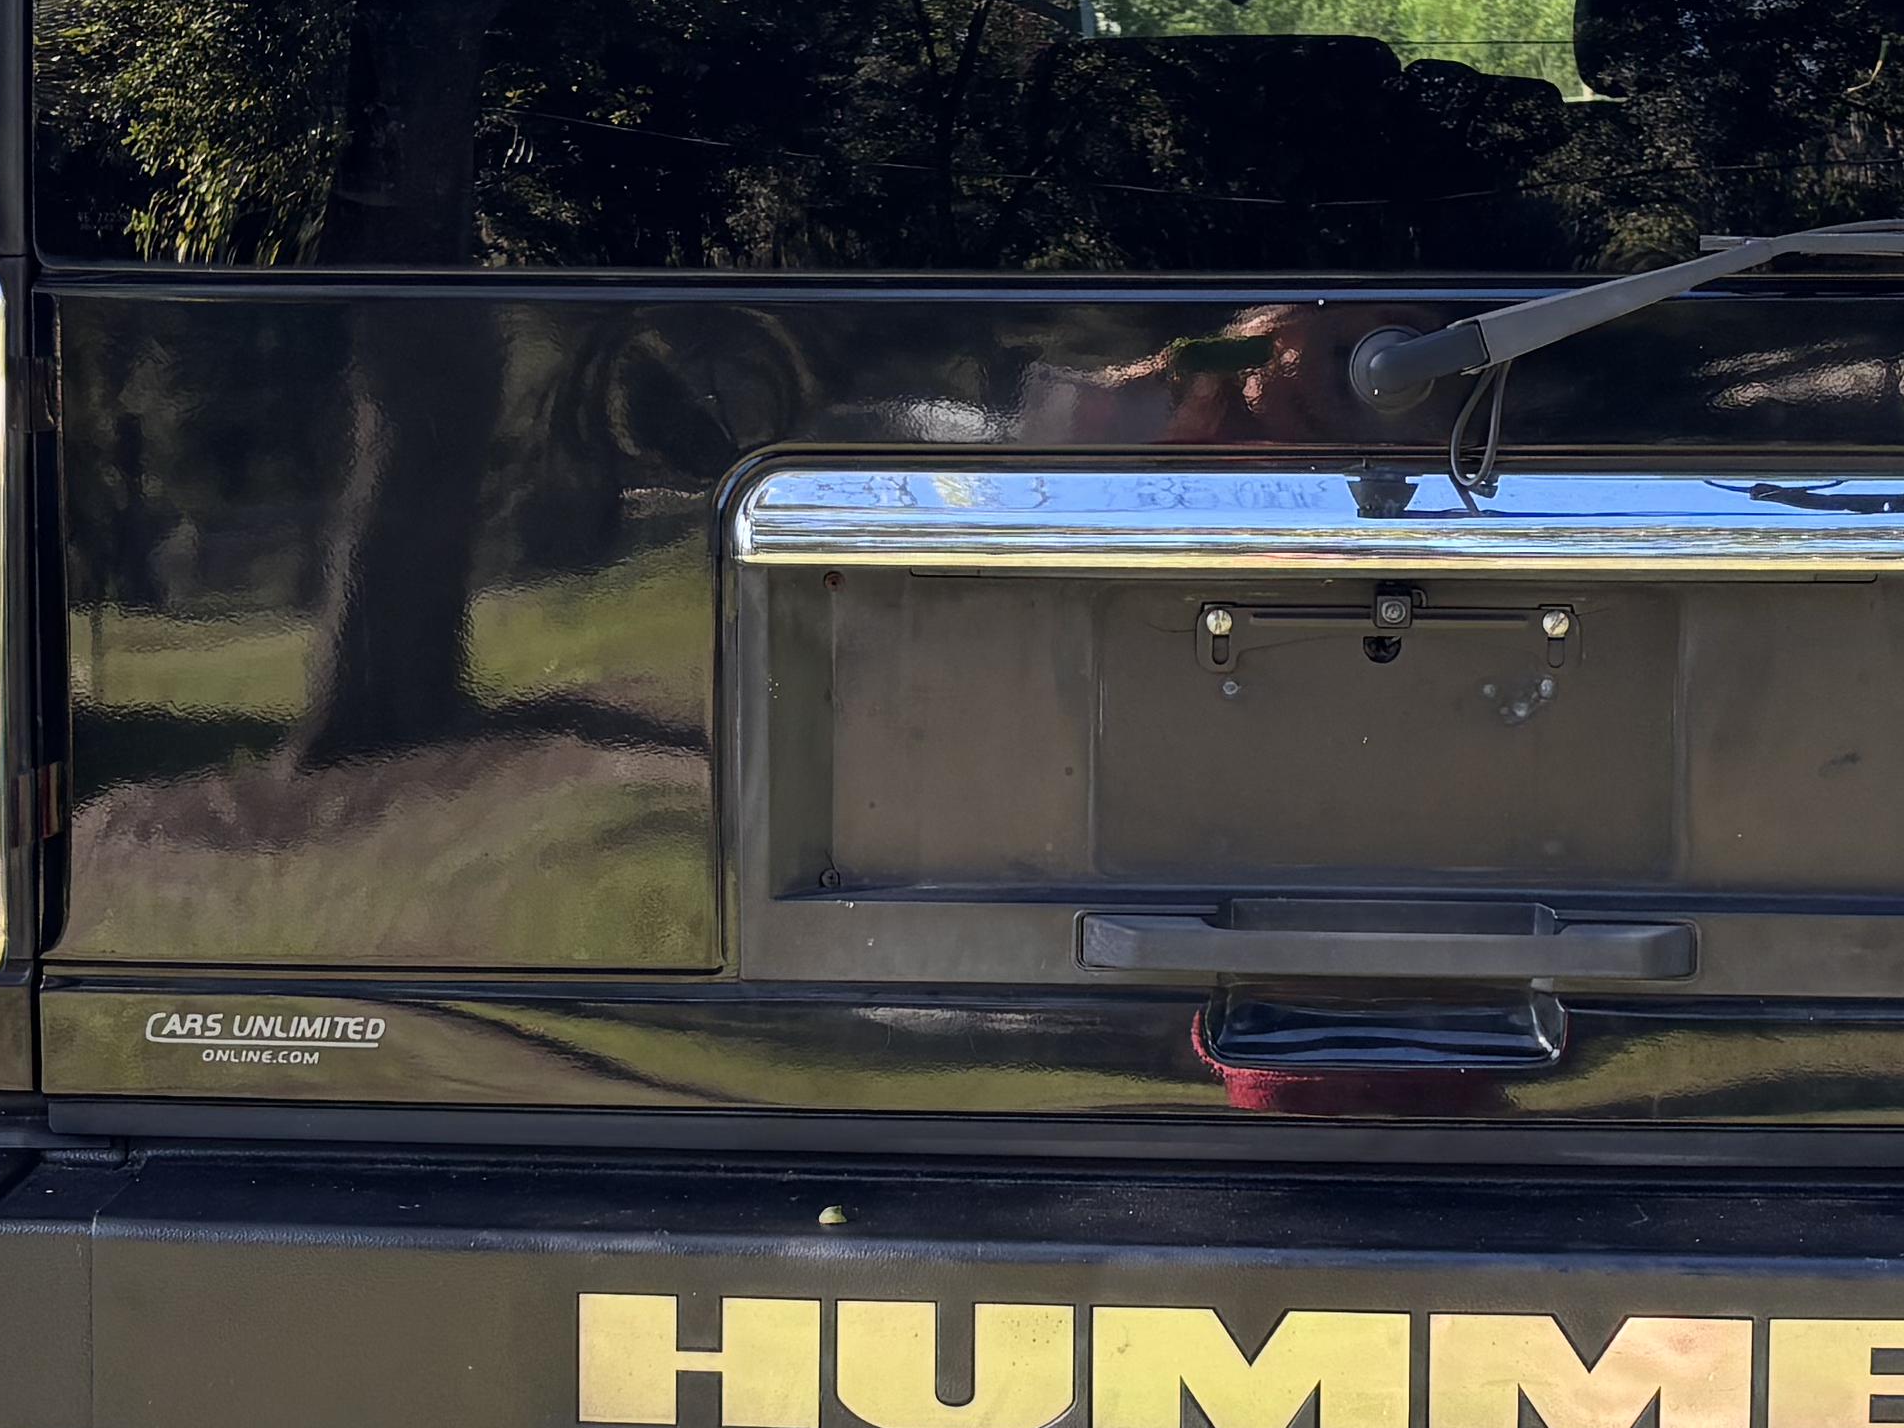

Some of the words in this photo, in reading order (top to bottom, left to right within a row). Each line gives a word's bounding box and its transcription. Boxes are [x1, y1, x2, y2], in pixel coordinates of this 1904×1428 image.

[145, 1012, 224, 1041] CARS
[232, 1014, 386, 1041] UNLIMITED
[202, 1048, 320, 1065] ONLINE.COM
